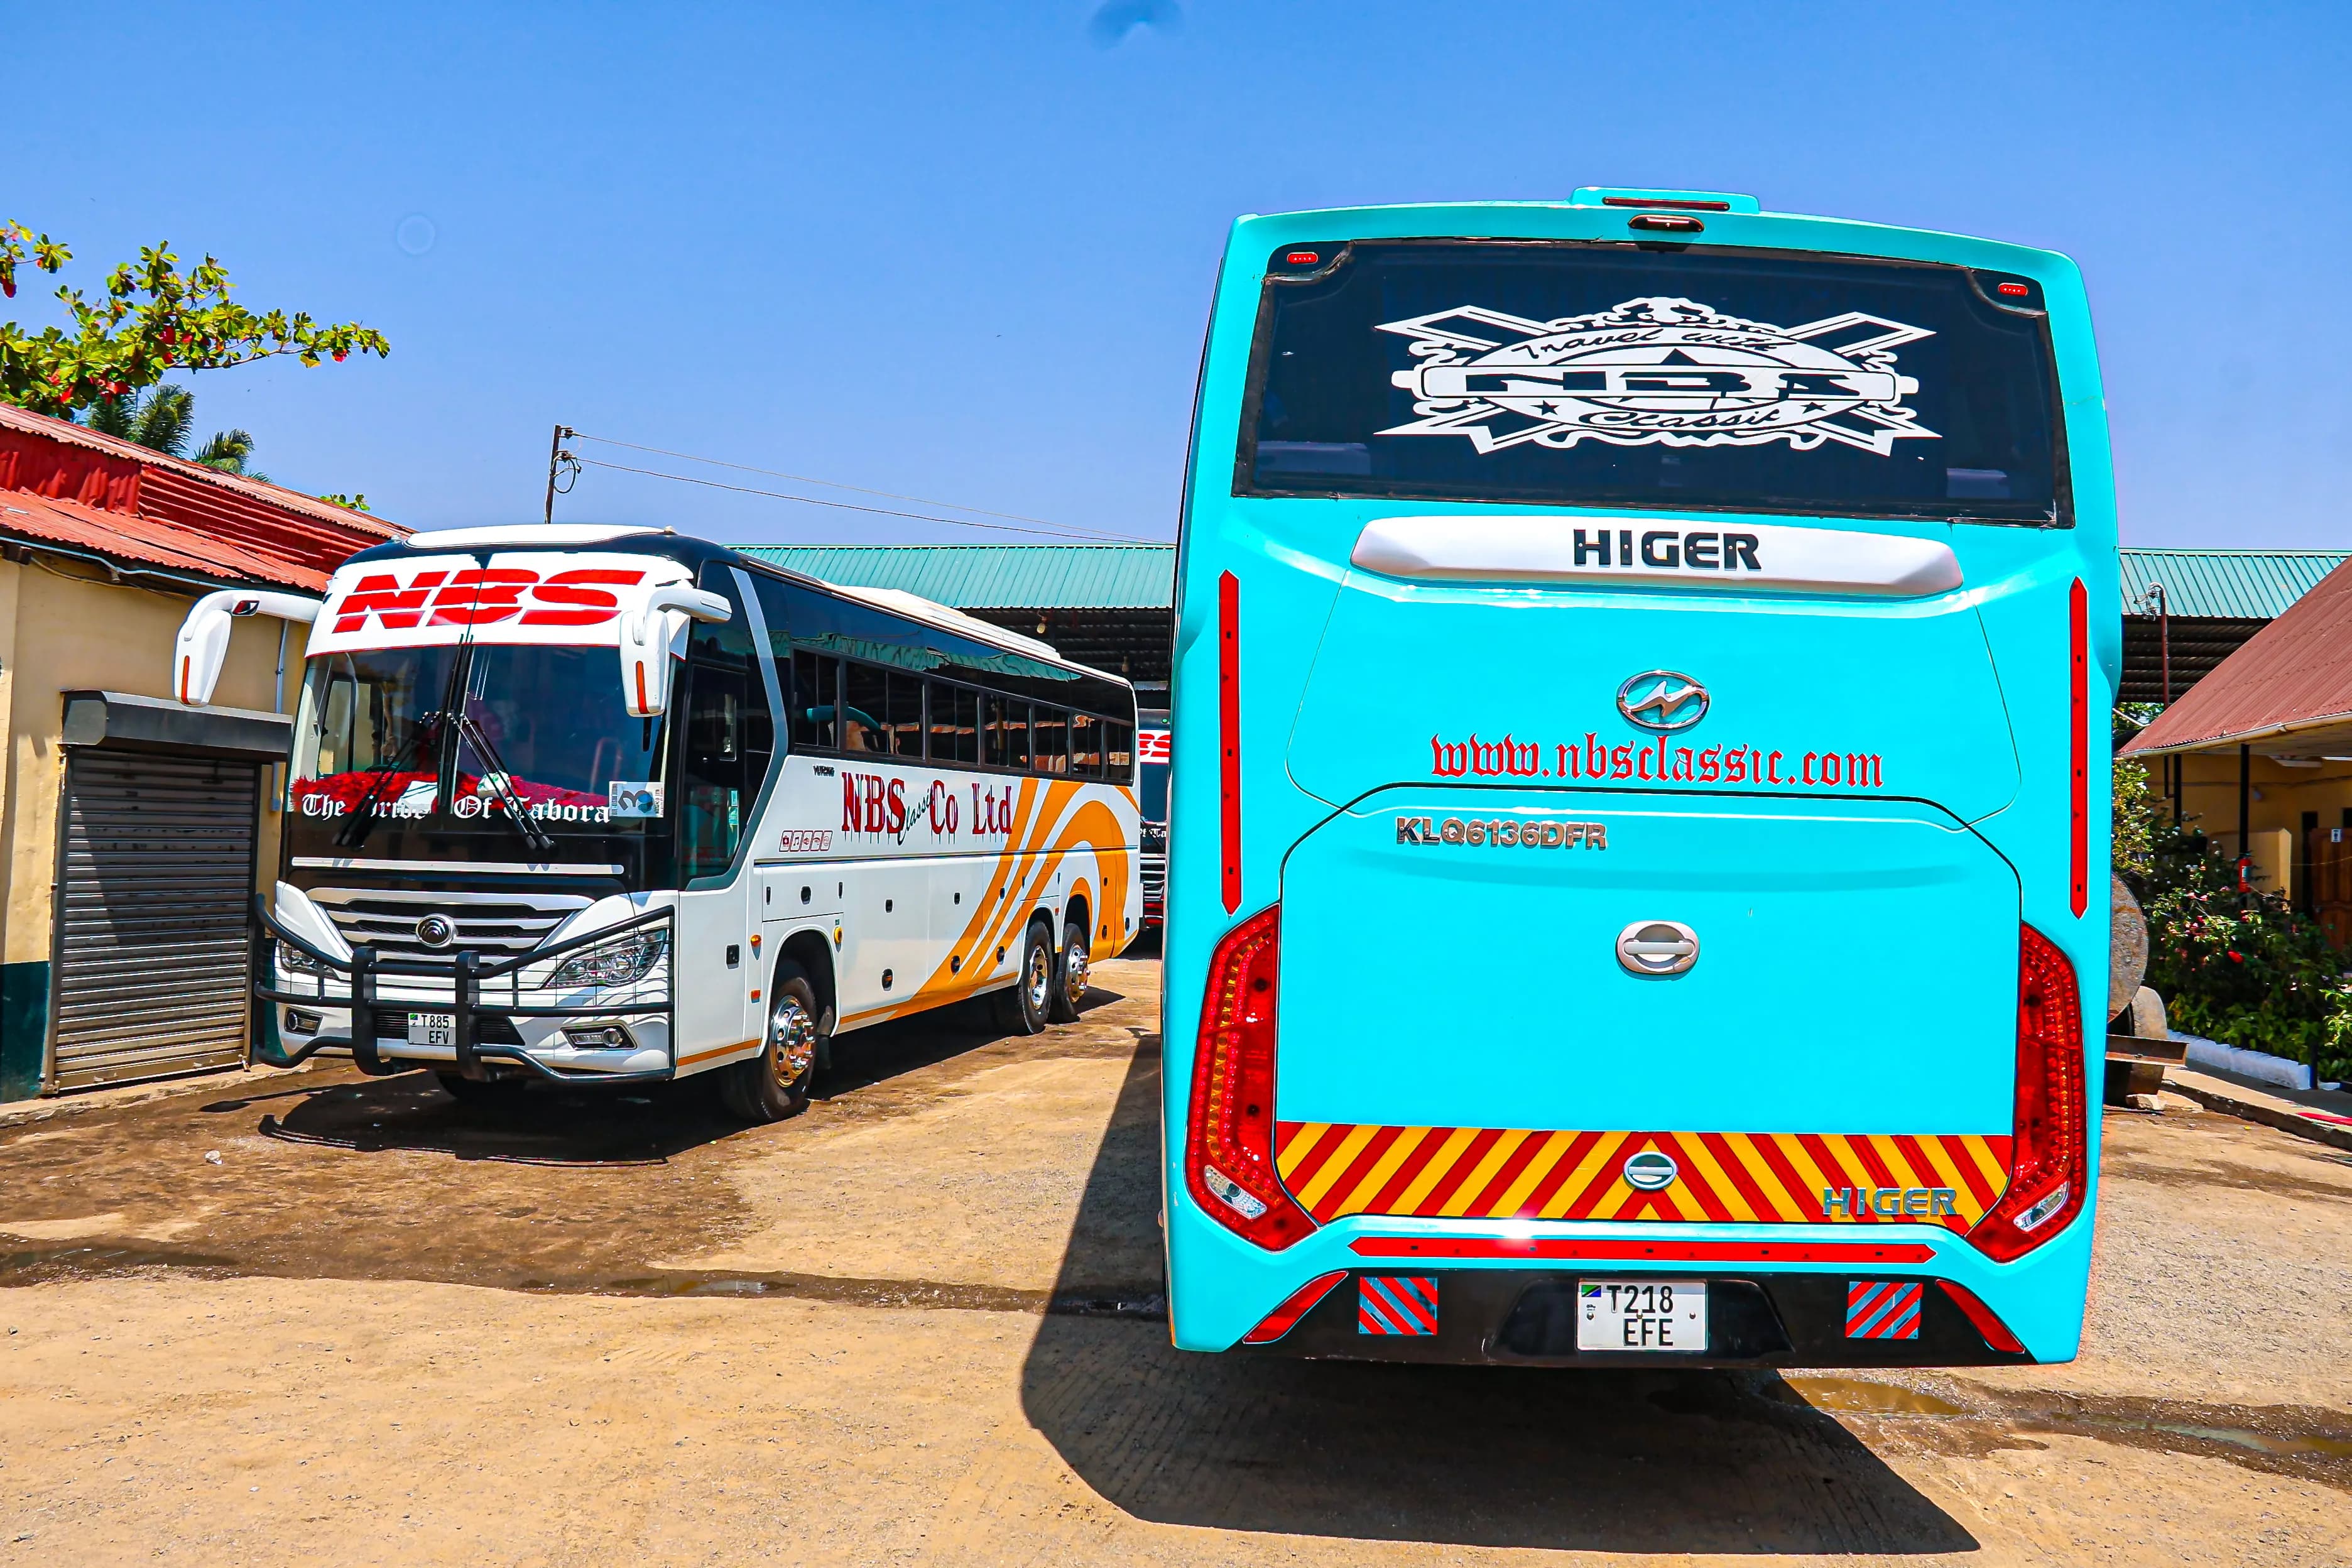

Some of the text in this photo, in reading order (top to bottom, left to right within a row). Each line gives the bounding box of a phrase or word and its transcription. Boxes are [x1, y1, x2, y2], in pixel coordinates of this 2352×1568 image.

[1511, 329, 1664, 359] Travel
[1573, 528, 1761, 570] HIGER
[331, 569, 646, 634] NBS
[1430, 732, 1884, 788] www.nbsclassic.com
[302, 793, 346, 821] The
[454, 795, 493, 819] Of
[841, 772, 905, 836] NBS
[930, 779, 958, 837] Co
[971, 782, 1012, 836] Ltd
[1395, 816, 1608, 850] KLQ6136DFR
[428, 1030, 449, 1044] EFV
[1822, 1187, 1957, 1216] HIGER
[1623, 1318, 1674, 1347] EFE
